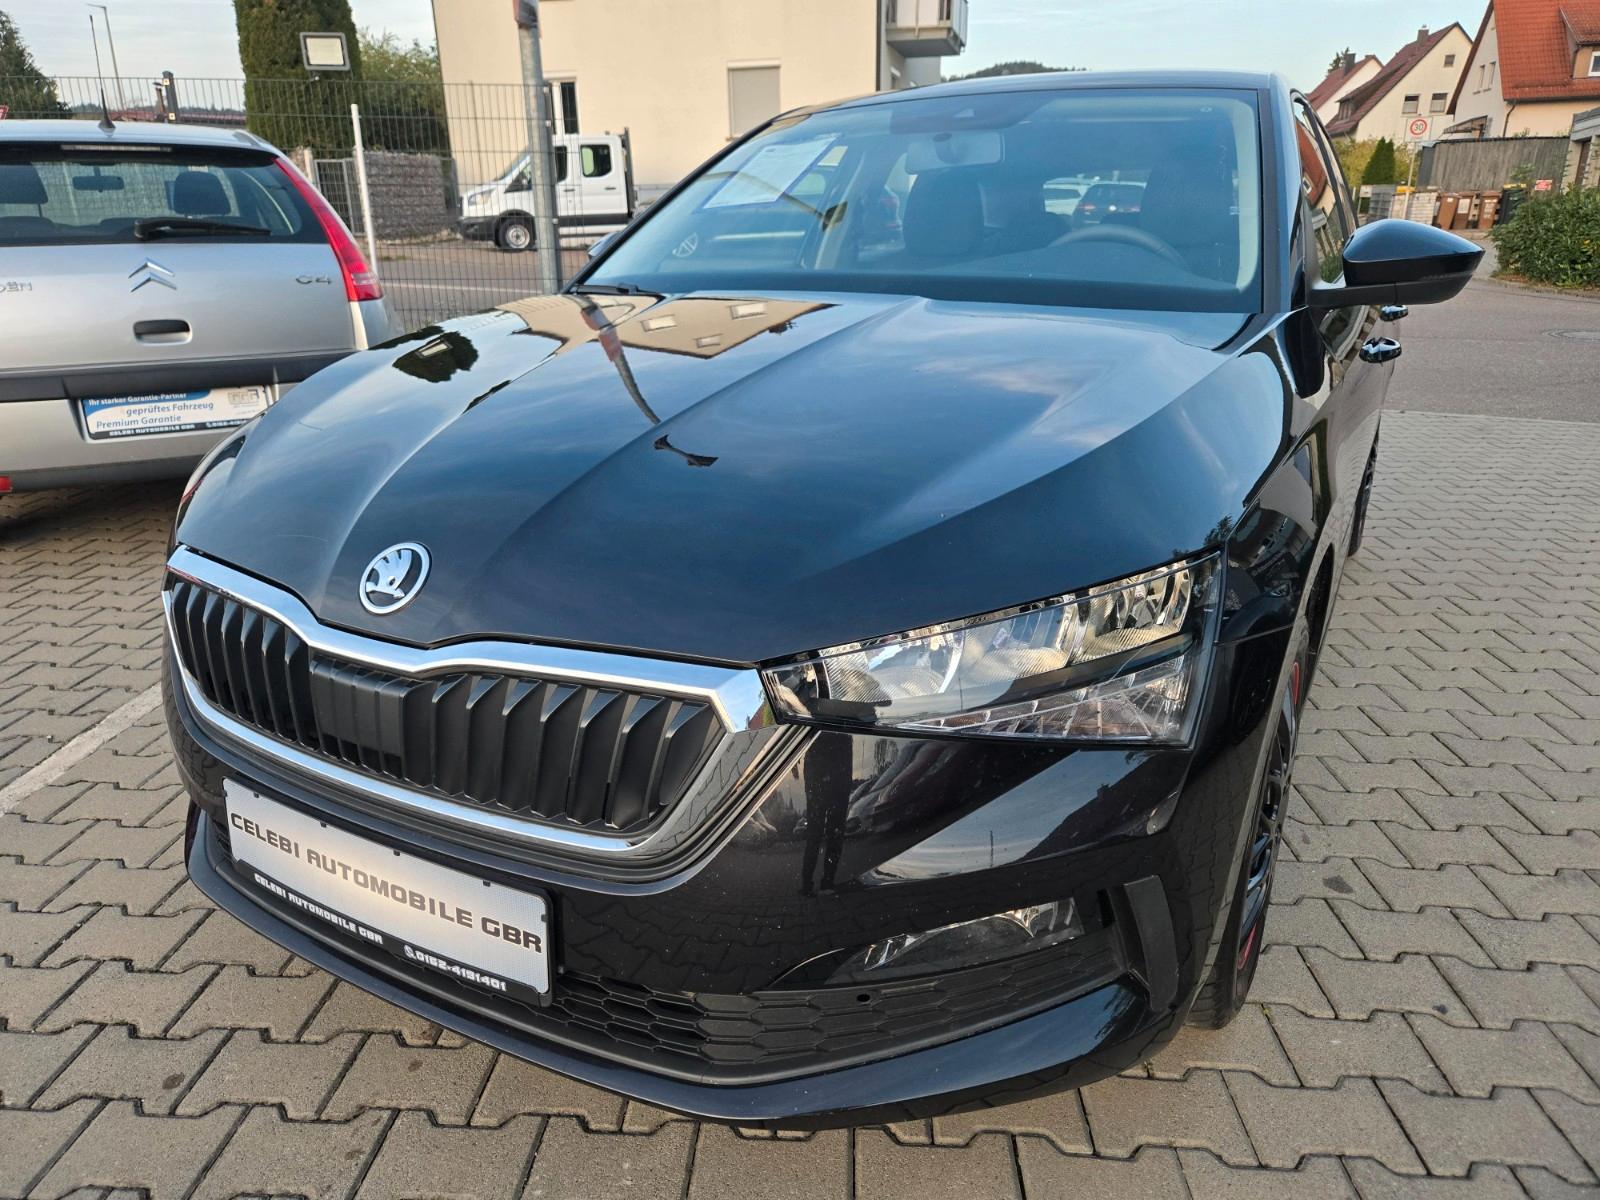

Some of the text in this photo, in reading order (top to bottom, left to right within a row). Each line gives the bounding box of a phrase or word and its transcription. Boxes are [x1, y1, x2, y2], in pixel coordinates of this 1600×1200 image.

[1414, 123, 1424, 131] 30
[295, 274, 331, 285] C4
[101, 397, 126, 405] starker
[127, 393, 187, 402] Garantie-Partner
[126, 402, 214, 416] geprüftes Fahrzeug
[96, 414, 181, 429] Premium Garantie
[231, 812, 543, 954] CELEBI AUTOMOBILE GBR
[254, 873, 384, 945] CELEBI AUTOMOBILE GBR
[415, 950, 507, 992] 0162-4191401
